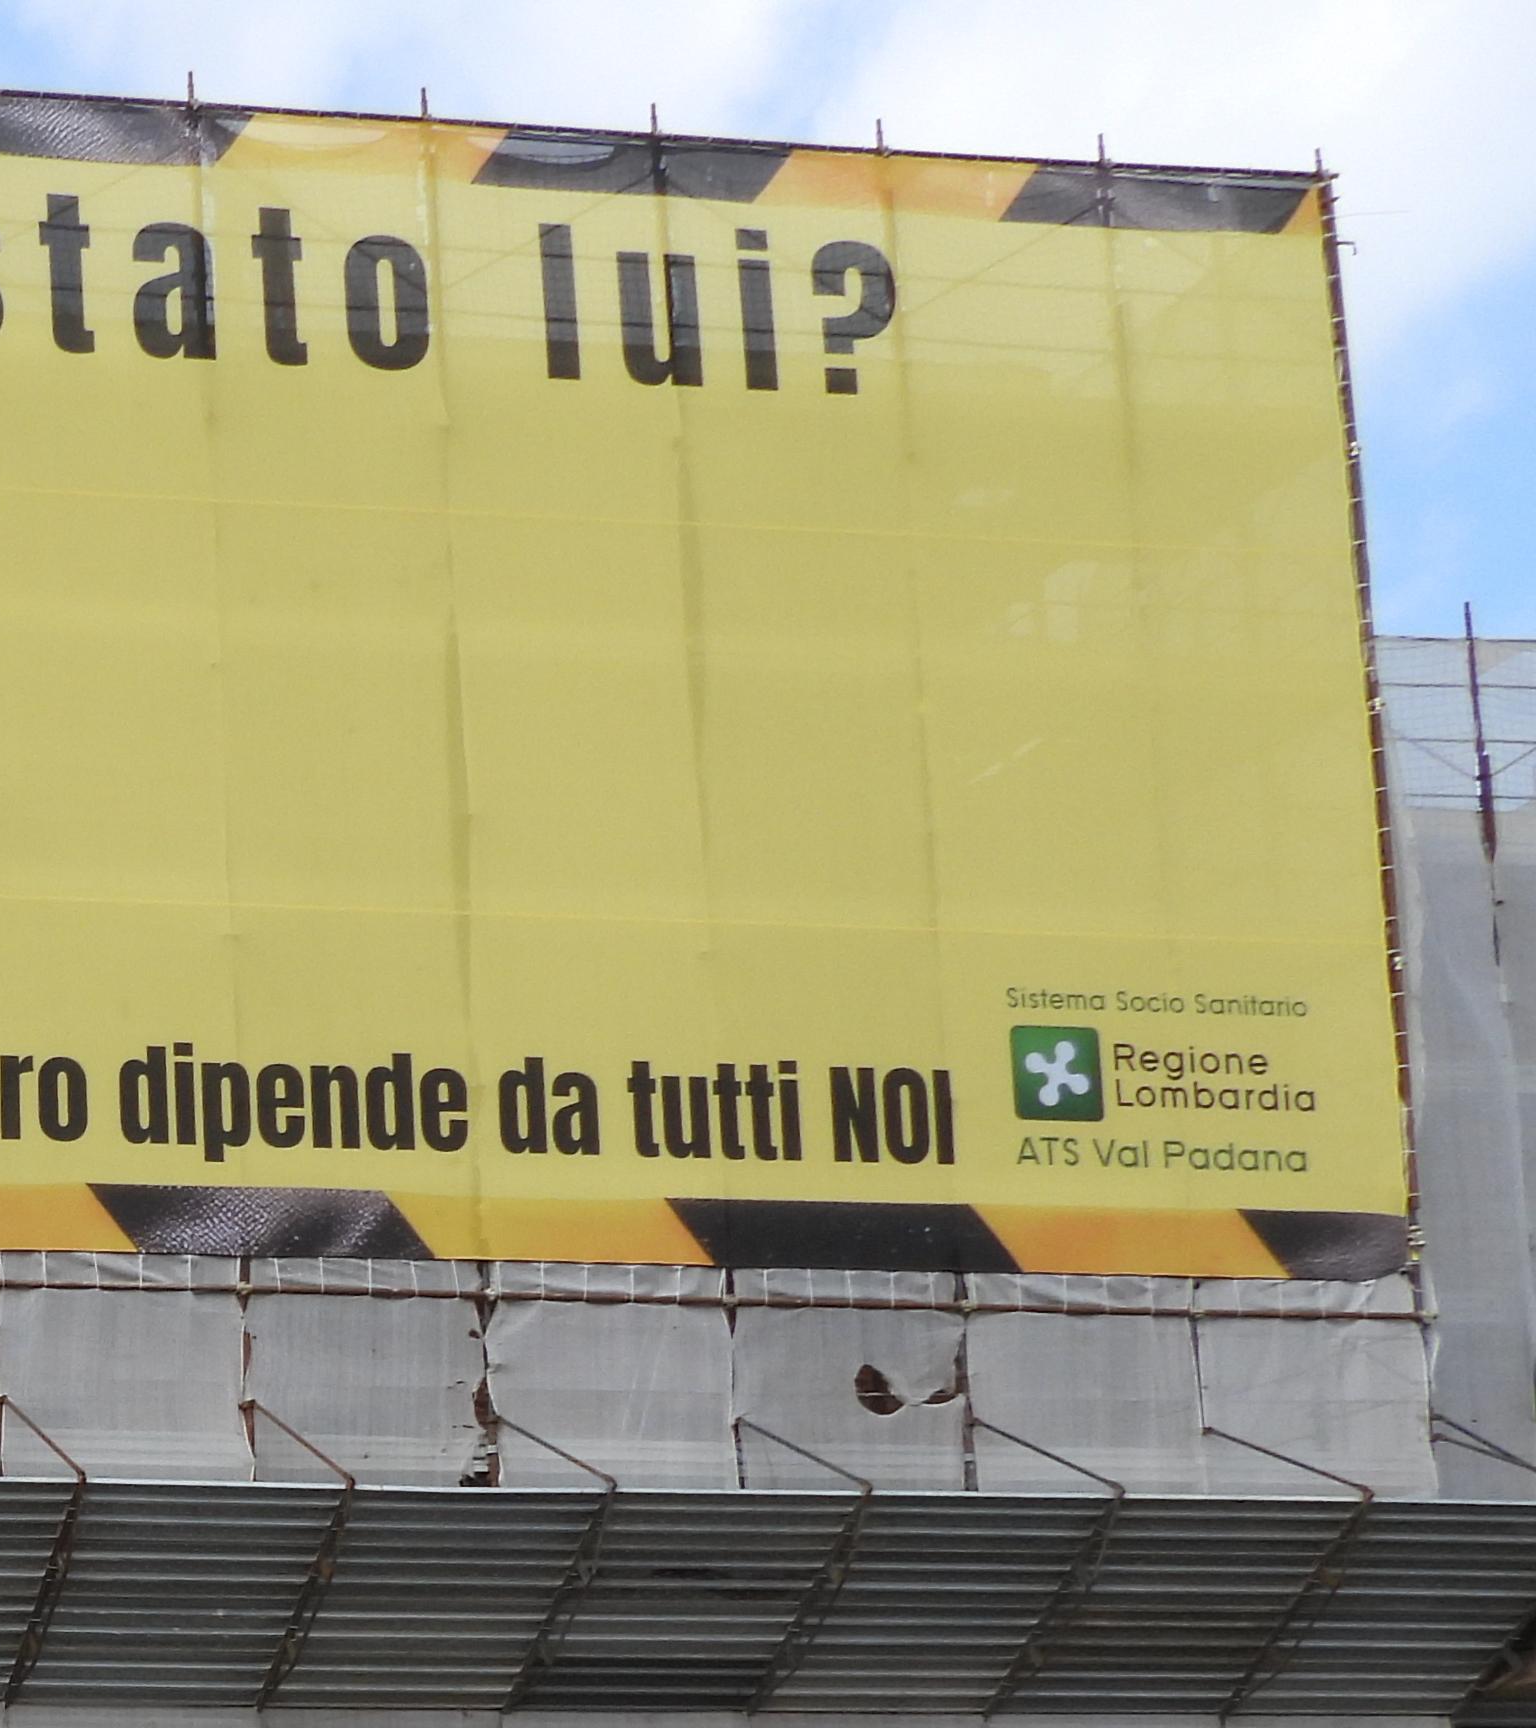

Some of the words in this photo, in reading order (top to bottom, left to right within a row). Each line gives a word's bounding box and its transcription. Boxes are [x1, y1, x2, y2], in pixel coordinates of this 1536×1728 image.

[539, 223, 897, 395] lui?
[1006, 987, 1105, 1011] Sistema
[1116, 991, 1184, 1013] Socio
[1195, 993, 1308, 1017] Sanitario
[1113, 1043, 1269, 1080] Regione
[118, 1042, 469, 1163] dipende
[498, 1056, 600, 1156] da
[626, 1060, 803, 1161] tutti
[829, 1066, 956, 1166] NOI
[1115, 1079, 1316, 1112] Lombardia
[1017, 1137, 1080, 1166] ATS
[1093, 1139, 1150, 1168] Val
[1163, 1141, 1308, 1172] Padana
